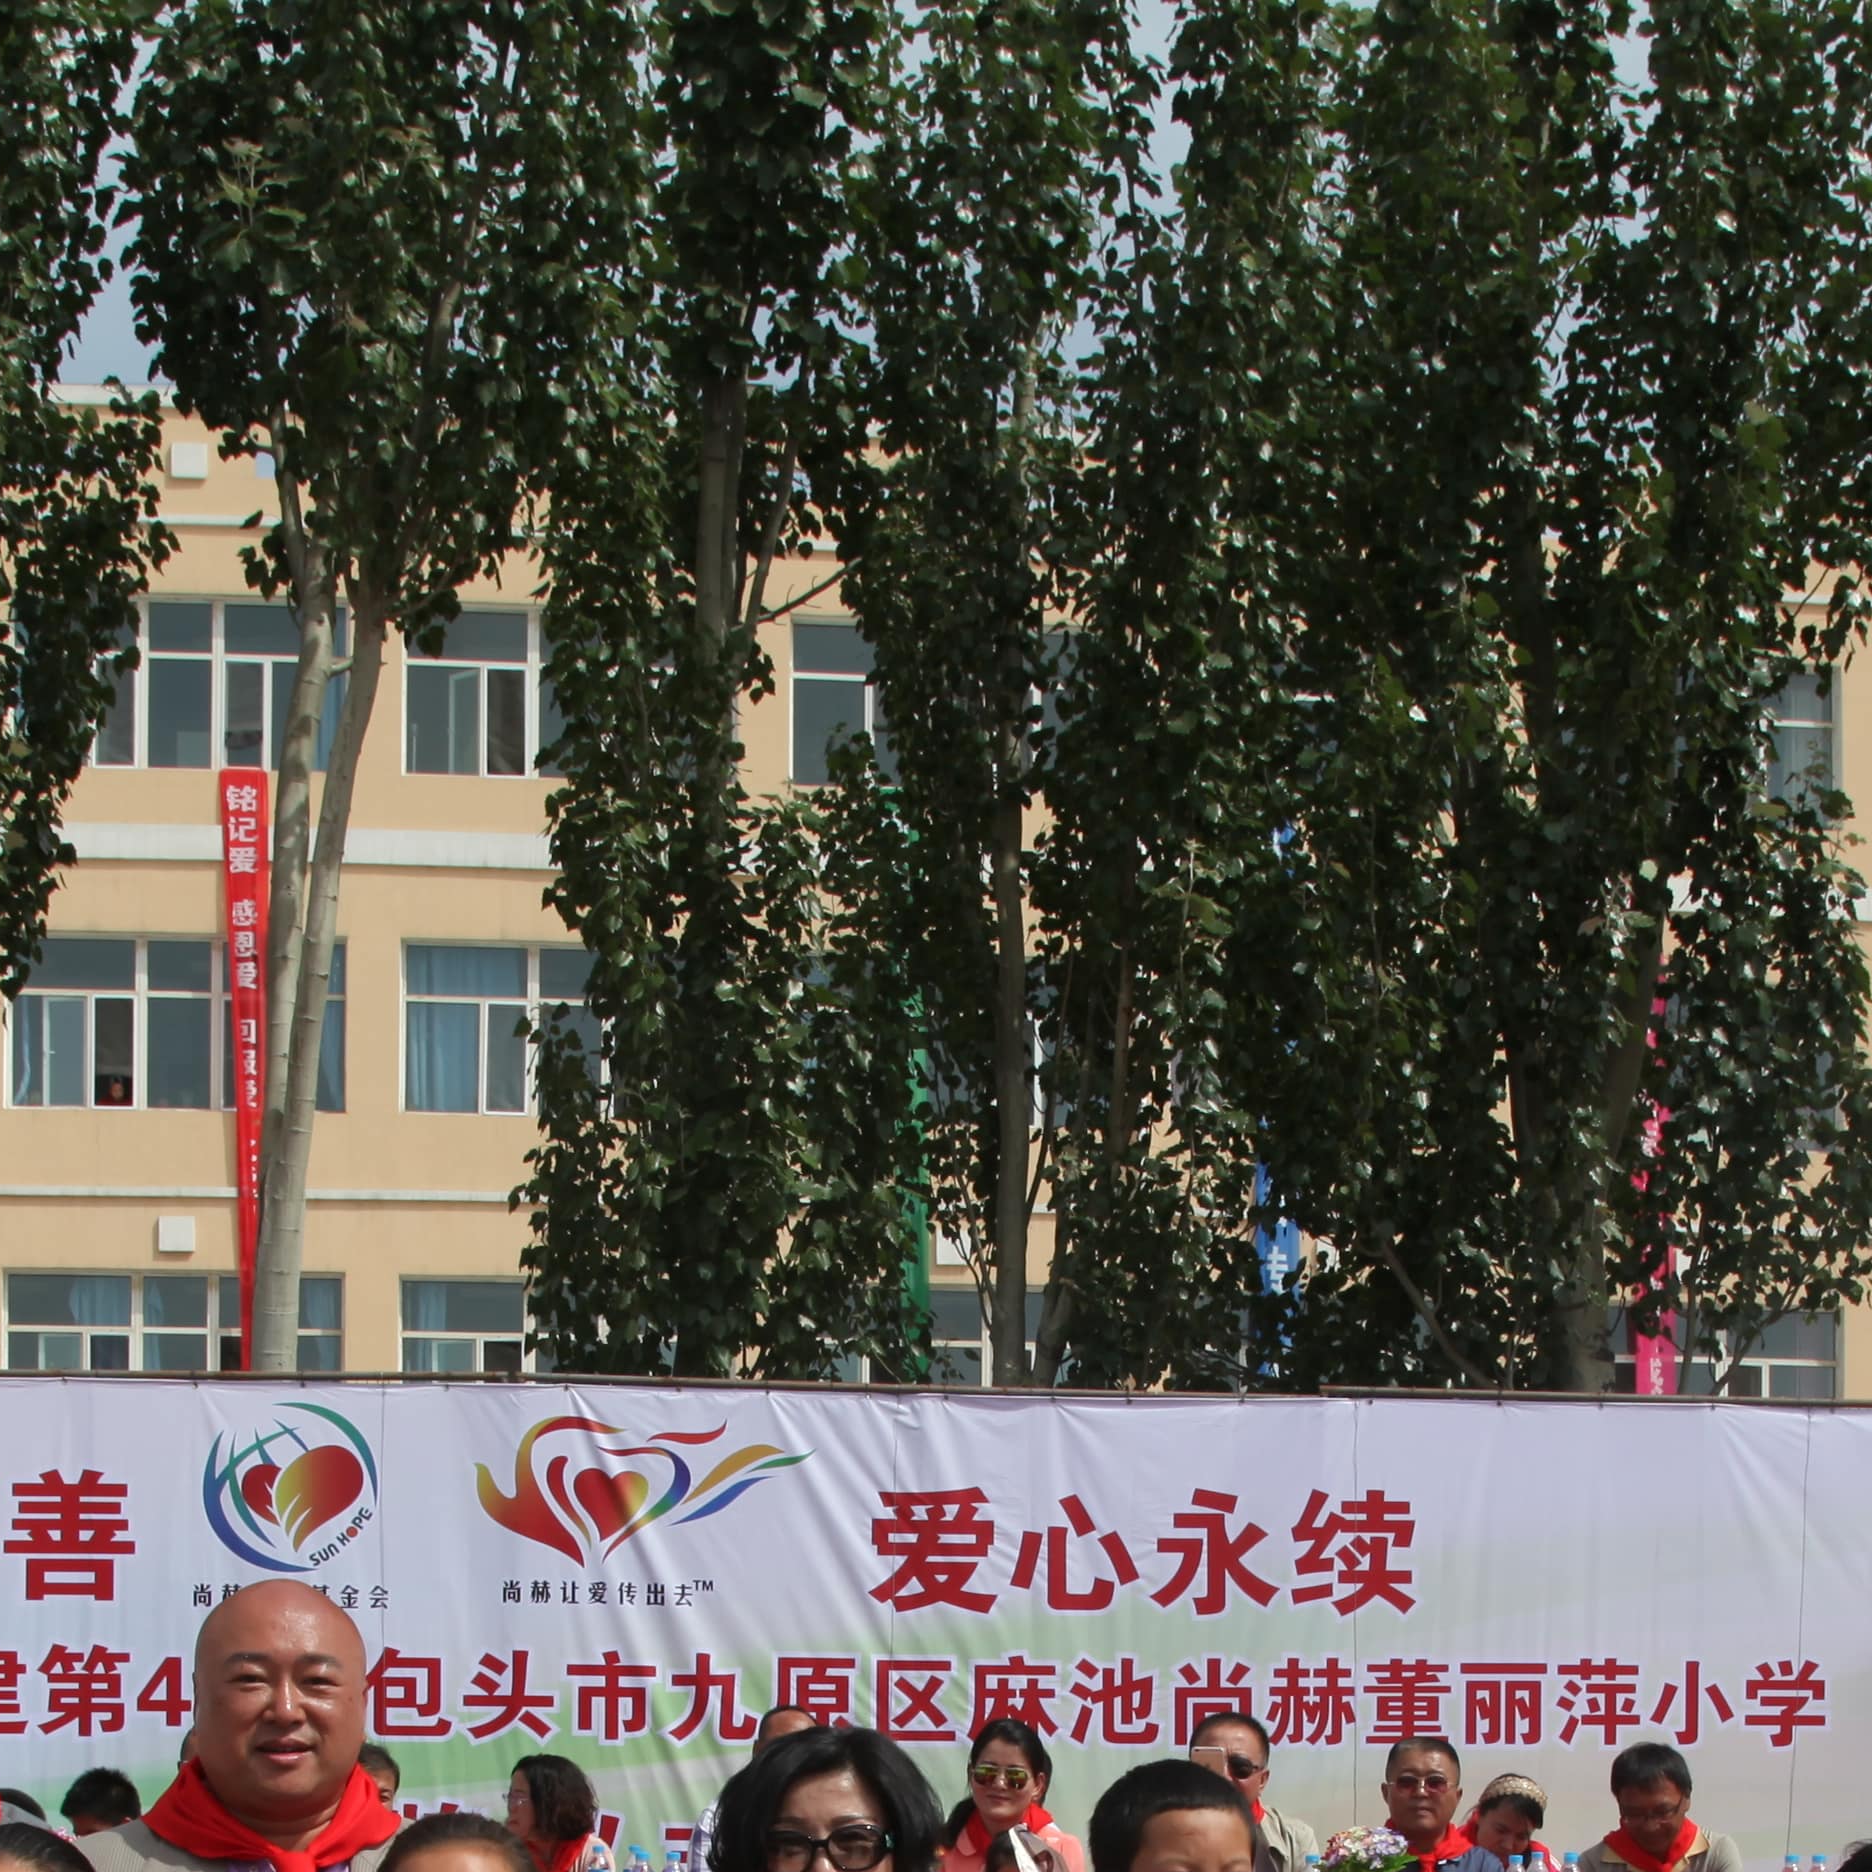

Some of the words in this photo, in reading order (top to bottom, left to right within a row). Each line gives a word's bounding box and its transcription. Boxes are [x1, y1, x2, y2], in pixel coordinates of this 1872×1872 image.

[309, 1542, 340, 1567] SUN
[336, 1506, 374, 1547] HOPE
[869, 1486, 1416, 1614] 爱心永续
[502, 1579, 694, 1607] 尚赫让爱传出去
